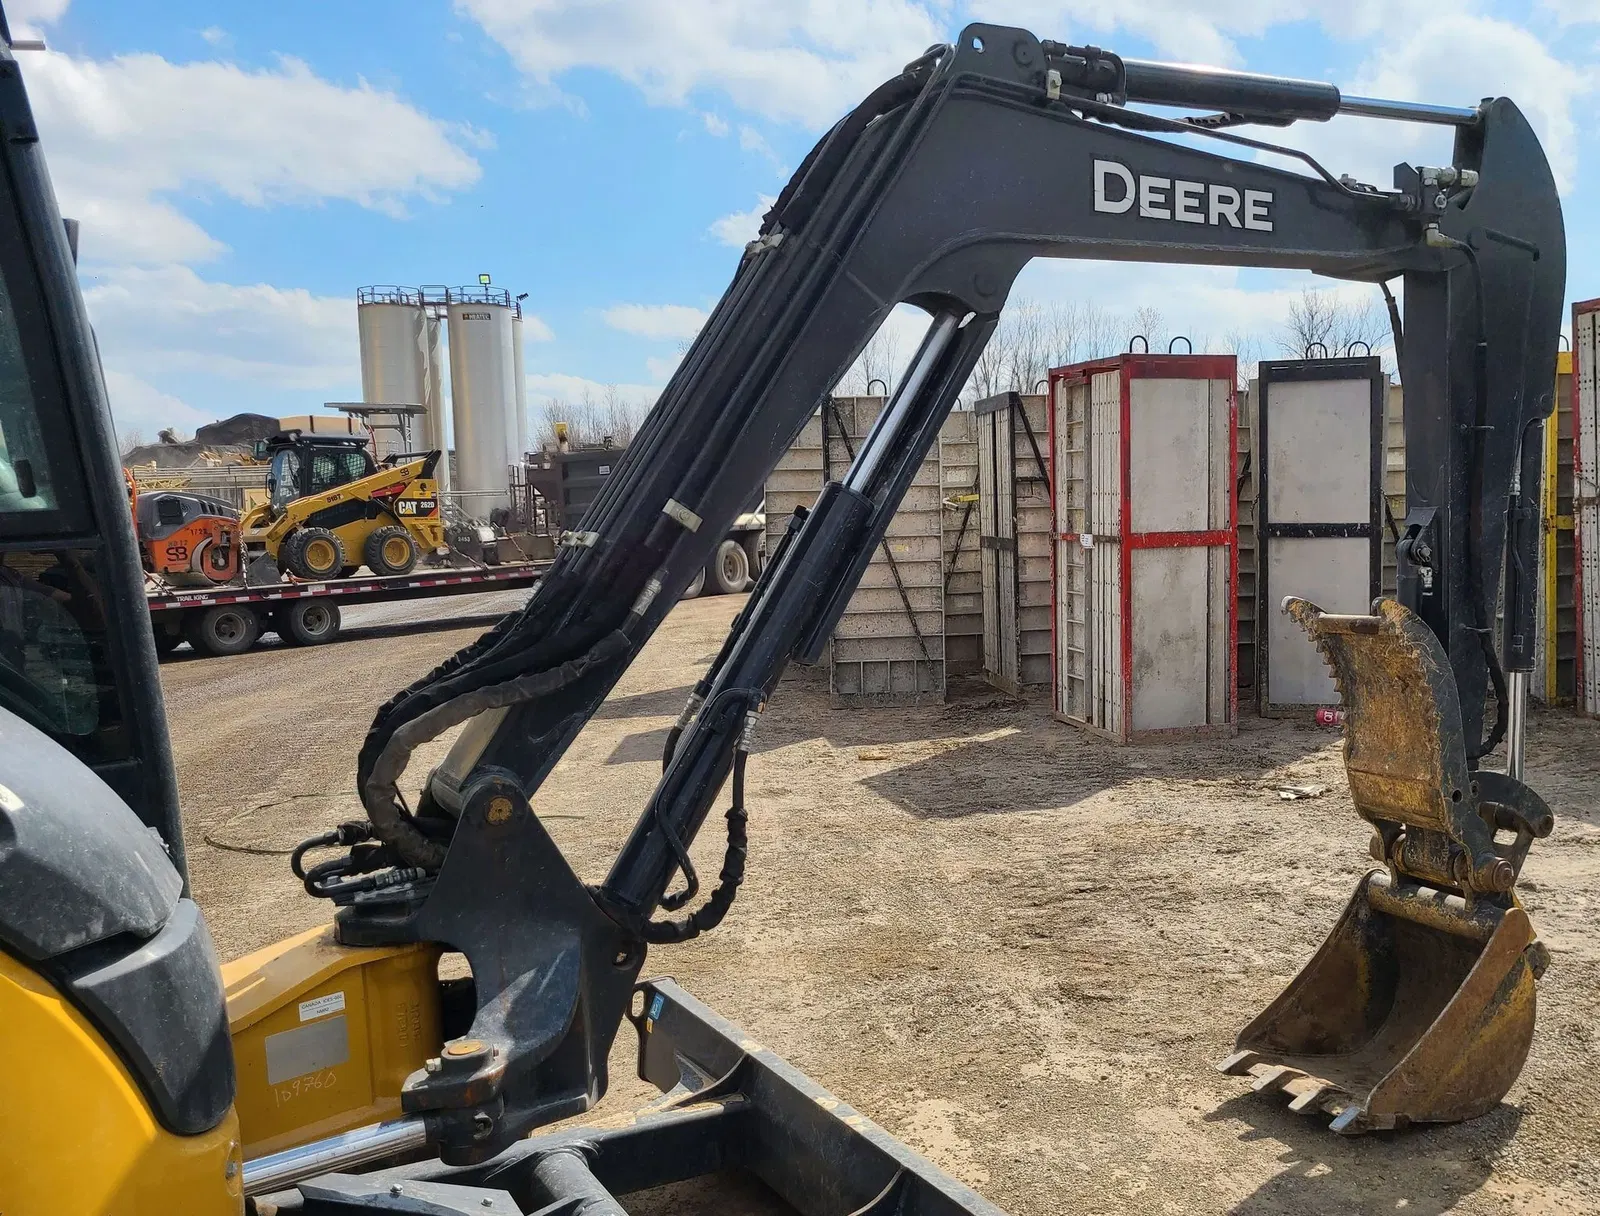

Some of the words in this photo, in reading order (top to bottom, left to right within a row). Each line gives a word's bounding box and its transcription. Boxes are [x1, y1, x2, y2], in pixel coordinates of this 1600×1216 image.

[1094, 159, 1273, 232] DEERE
[398, 501, 417, 515] CAT
[166, 546, 188, 561] SB
[301, 1000, 321, 1009] CANADA
